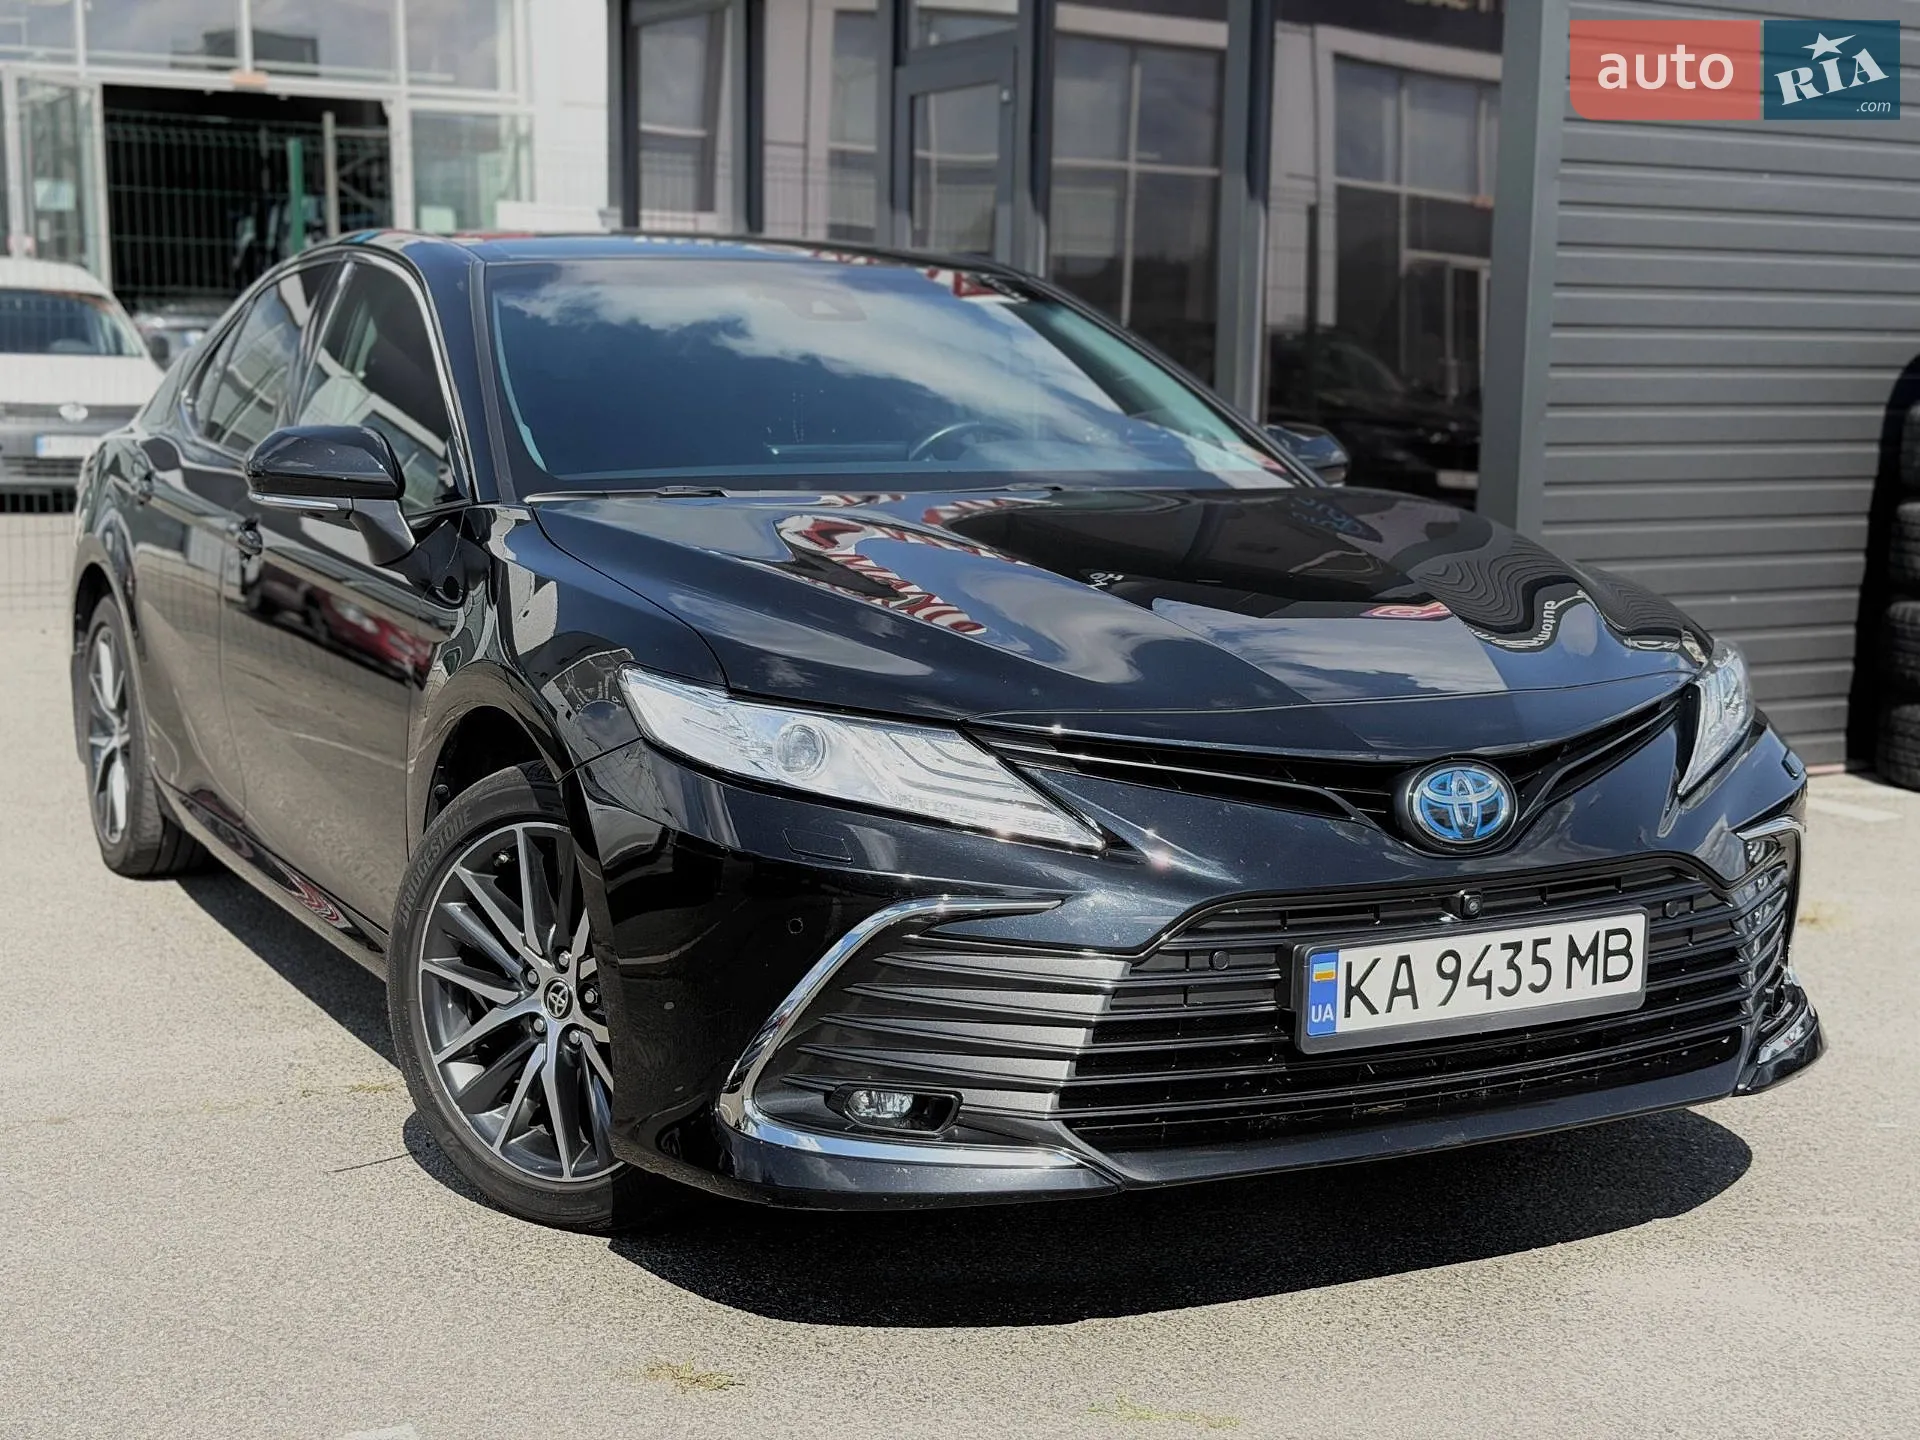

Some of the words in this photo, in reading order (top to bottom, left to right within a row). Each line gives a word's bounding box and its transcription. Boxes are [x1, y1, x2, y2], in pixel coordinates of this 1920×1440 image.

[1343, 954, 1419, 1019] KA
[1435, 937, 1552, 1007] 9435
[1565, 927, 1634, 990] MB
[1311, 1003, 1334, 1023] UA
